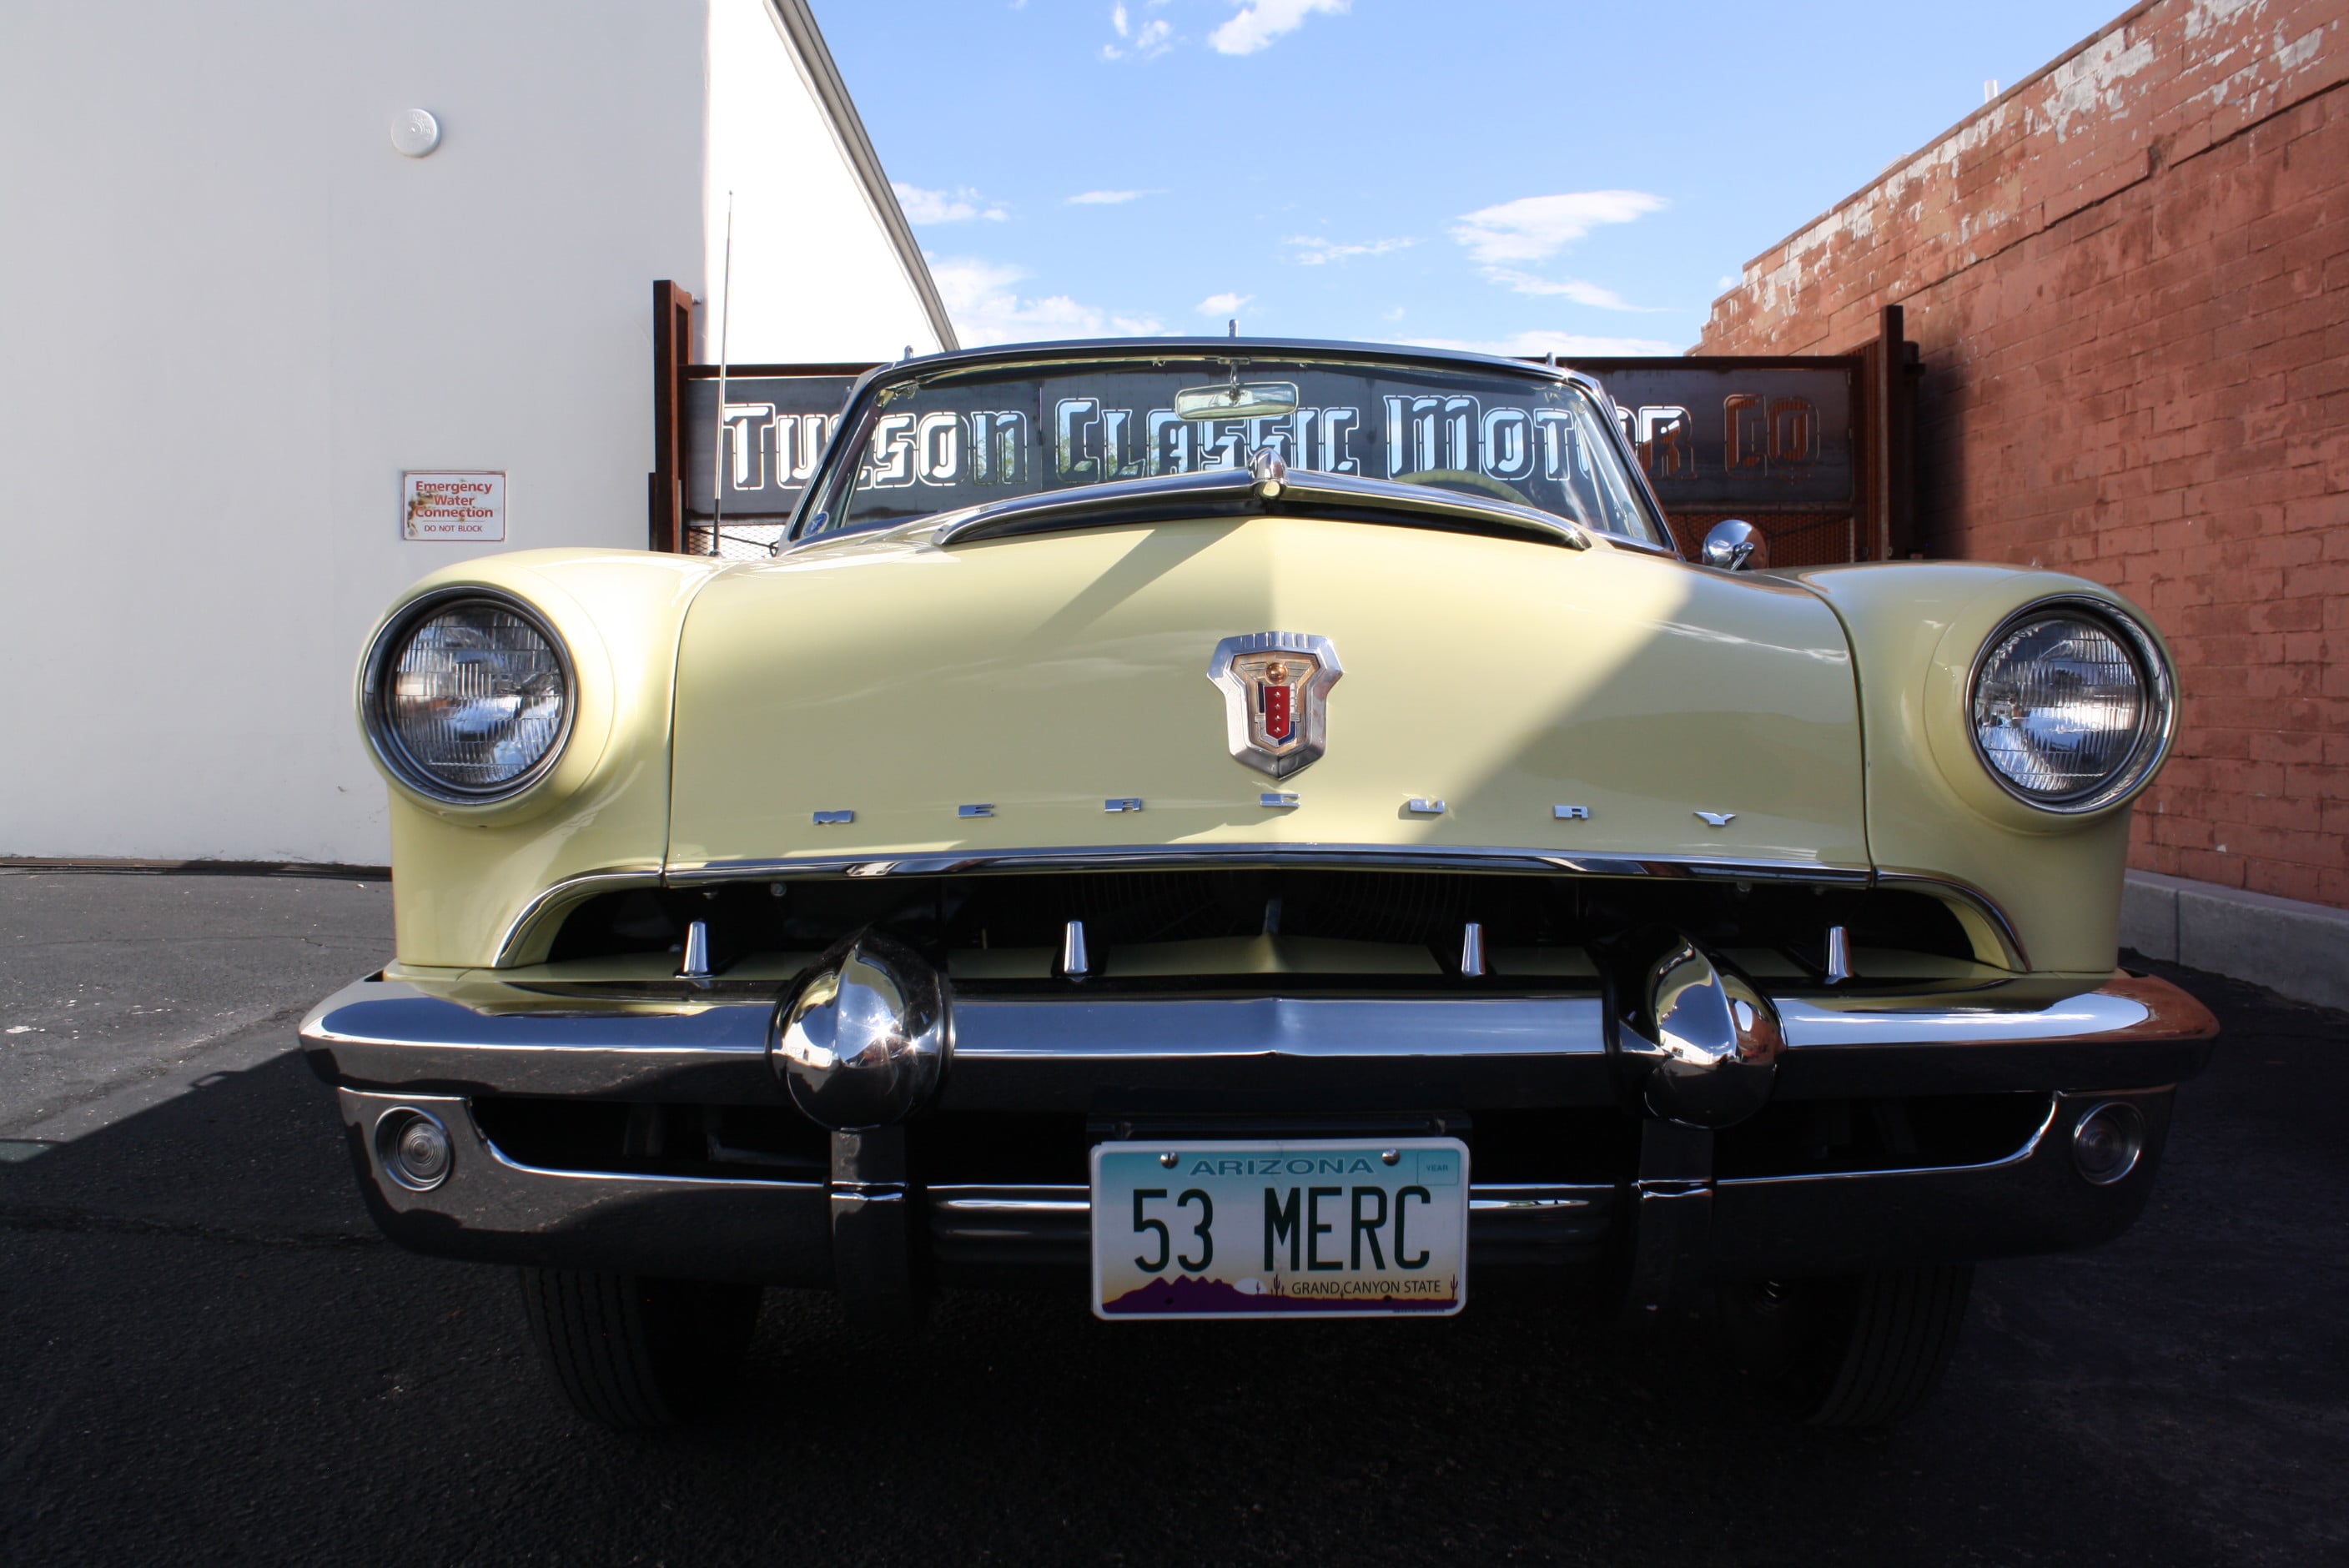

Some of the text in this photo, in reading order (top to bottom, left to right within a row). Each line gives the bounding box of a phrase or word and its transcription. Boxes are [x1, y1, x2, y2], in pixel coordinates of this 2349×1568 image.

[415, 480, 492, 495] Emergency
[434, 495, 475, 506] Water
[415, 506, 494, 518] Connection
[1189, 1157, 1449, 1176] ARIZONA YEAR
[1133, 1185, 1431, 1274] 53 MERC
[1291, 1279, 1441, 1295] GRAND CANYON STATE
